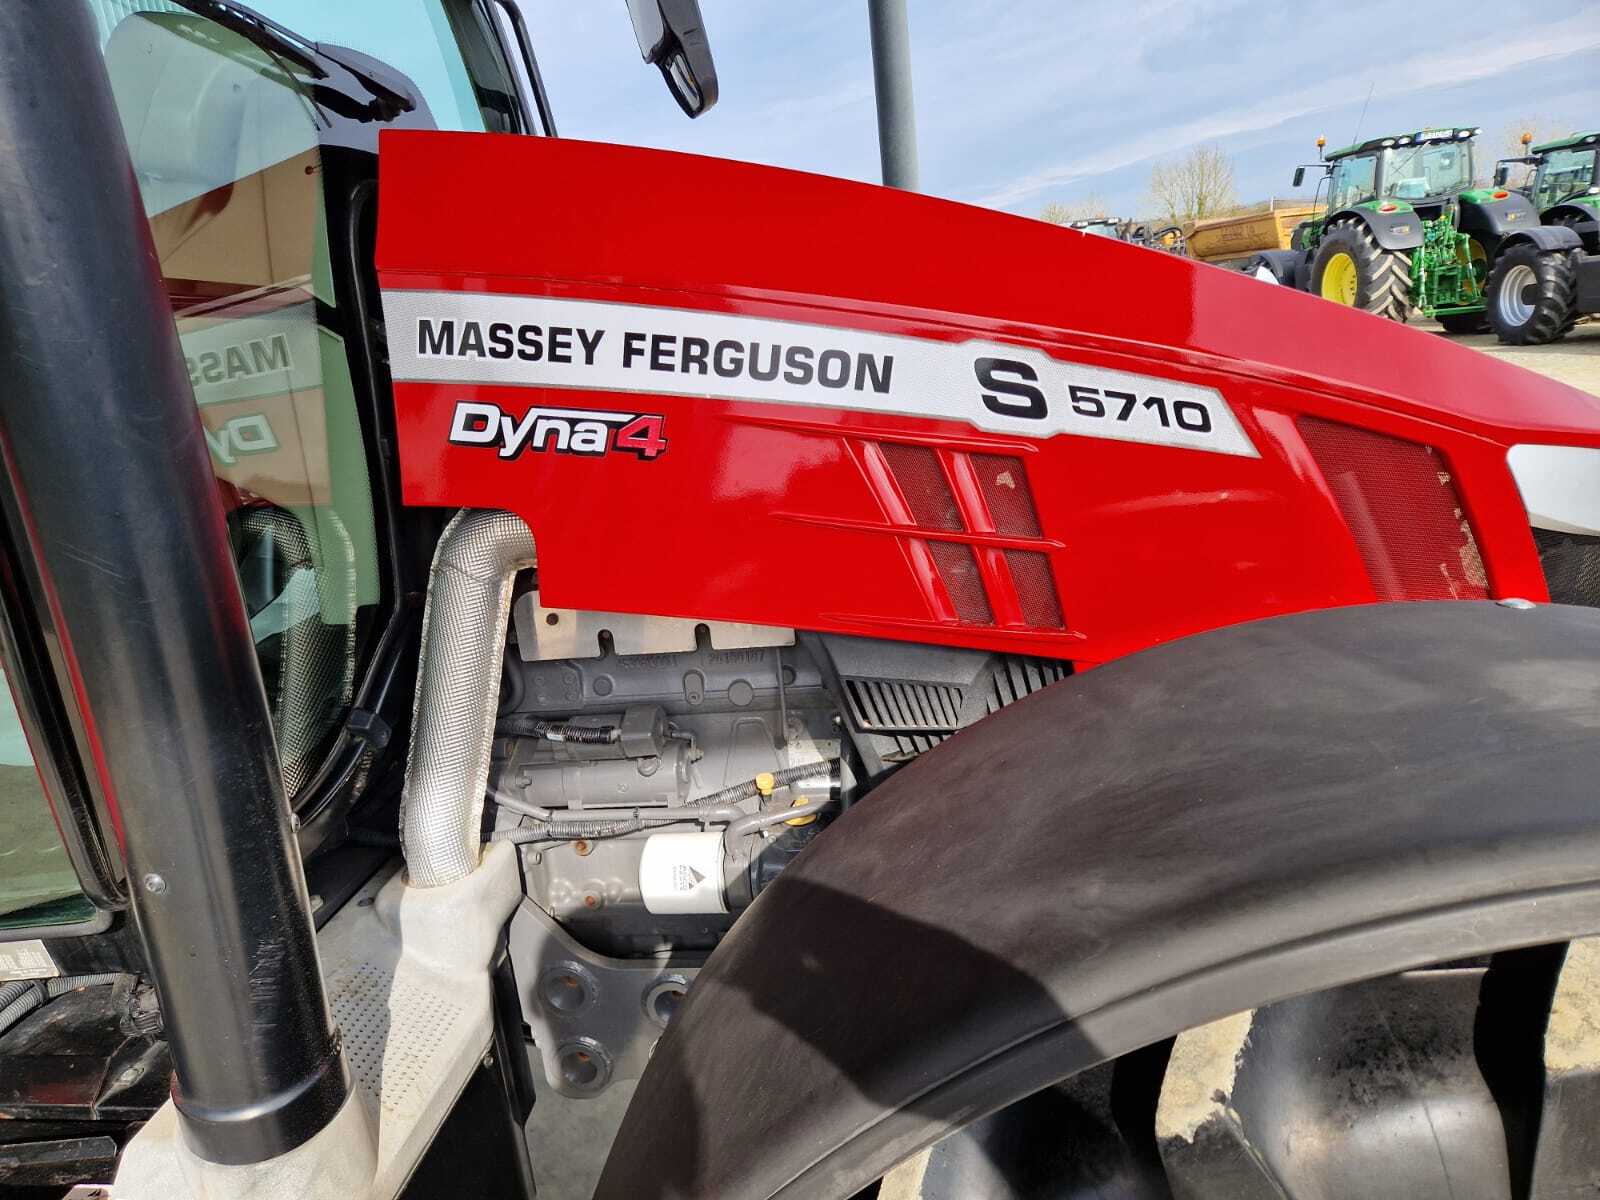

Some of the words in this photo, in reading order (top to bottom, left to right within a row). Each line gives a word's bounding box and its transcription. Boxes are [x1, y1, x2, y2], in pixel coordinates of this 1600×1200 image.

[418, 319, 605, 365] MASSEY
[622, 332, 895, 394] FERGUSON
[974, 357, 1048, 420] S
[1068, 385, 1213, 433] 5710
